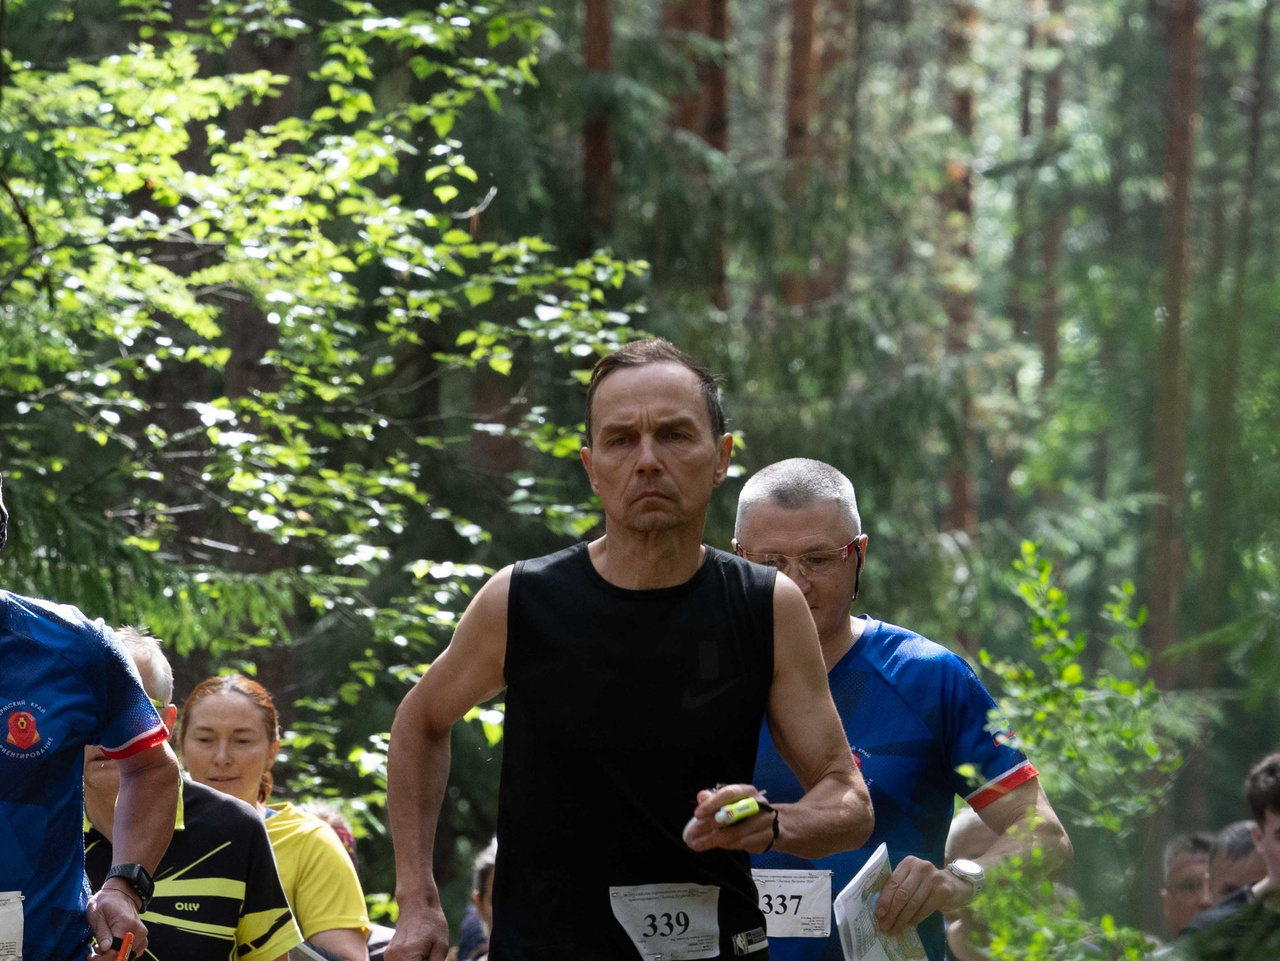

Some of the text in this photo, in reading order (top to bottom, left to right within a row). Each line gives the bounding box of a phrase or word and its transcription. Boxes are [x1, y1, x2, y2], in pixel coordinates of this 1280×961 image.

[30, 701, 47, 714] КРАЙ
[761, 893, 803, 915] 337
[642, 911, 690, 938] 339
